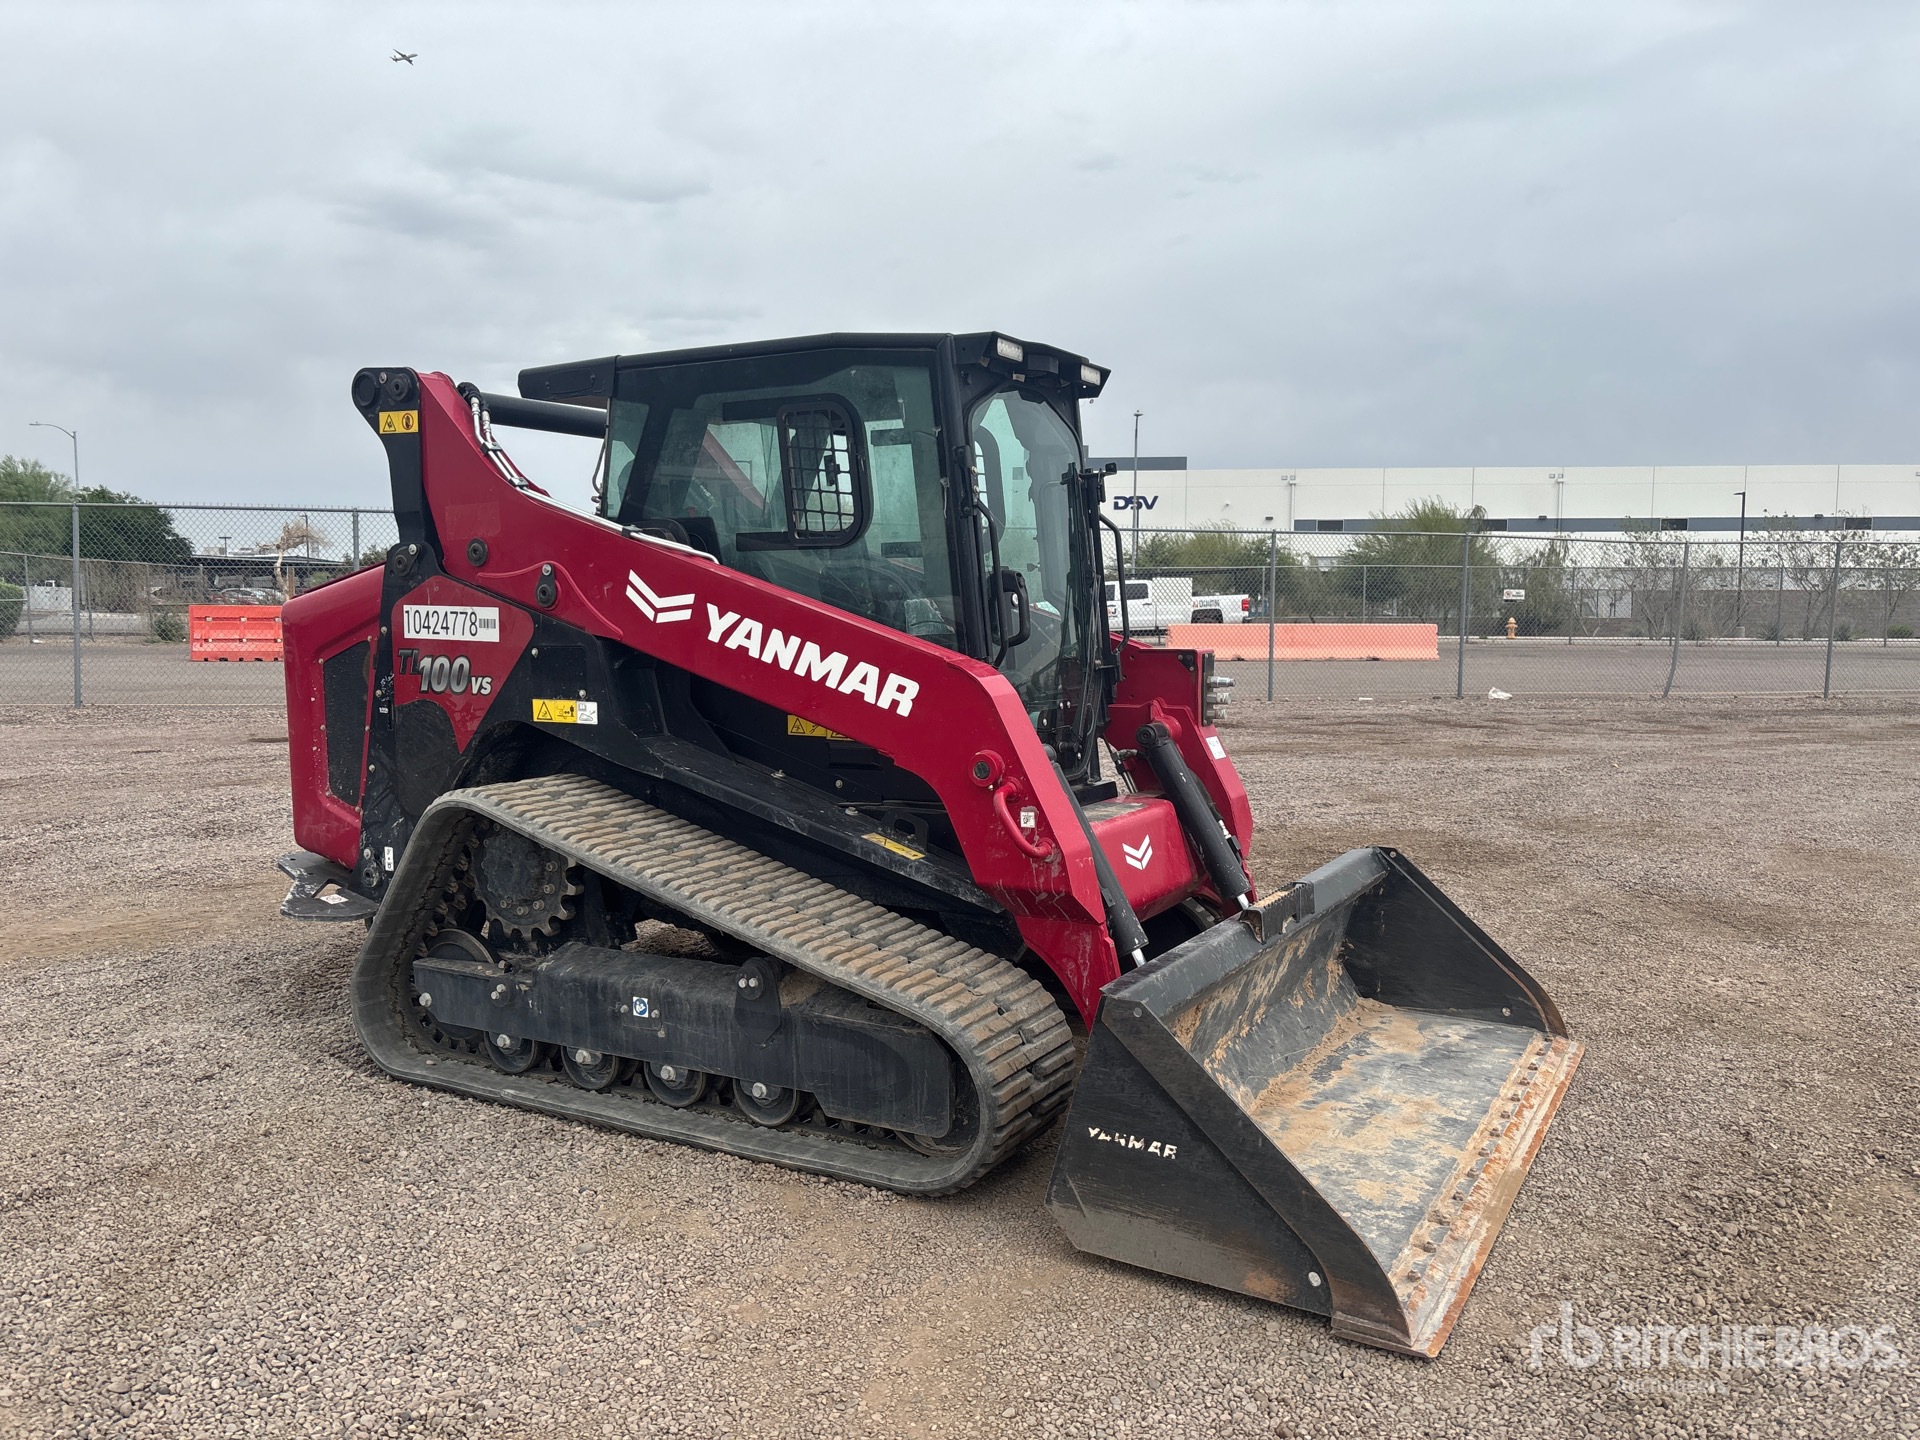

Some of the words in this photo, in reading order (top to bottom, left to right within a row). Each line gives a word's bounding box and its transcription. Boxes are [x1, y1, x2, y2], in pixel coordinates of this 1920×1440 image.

[1114, 496, 1158, 510] DSV
[405, 609, 478, 637] 10424778
[706, 603, 920, 717] YANMAR
